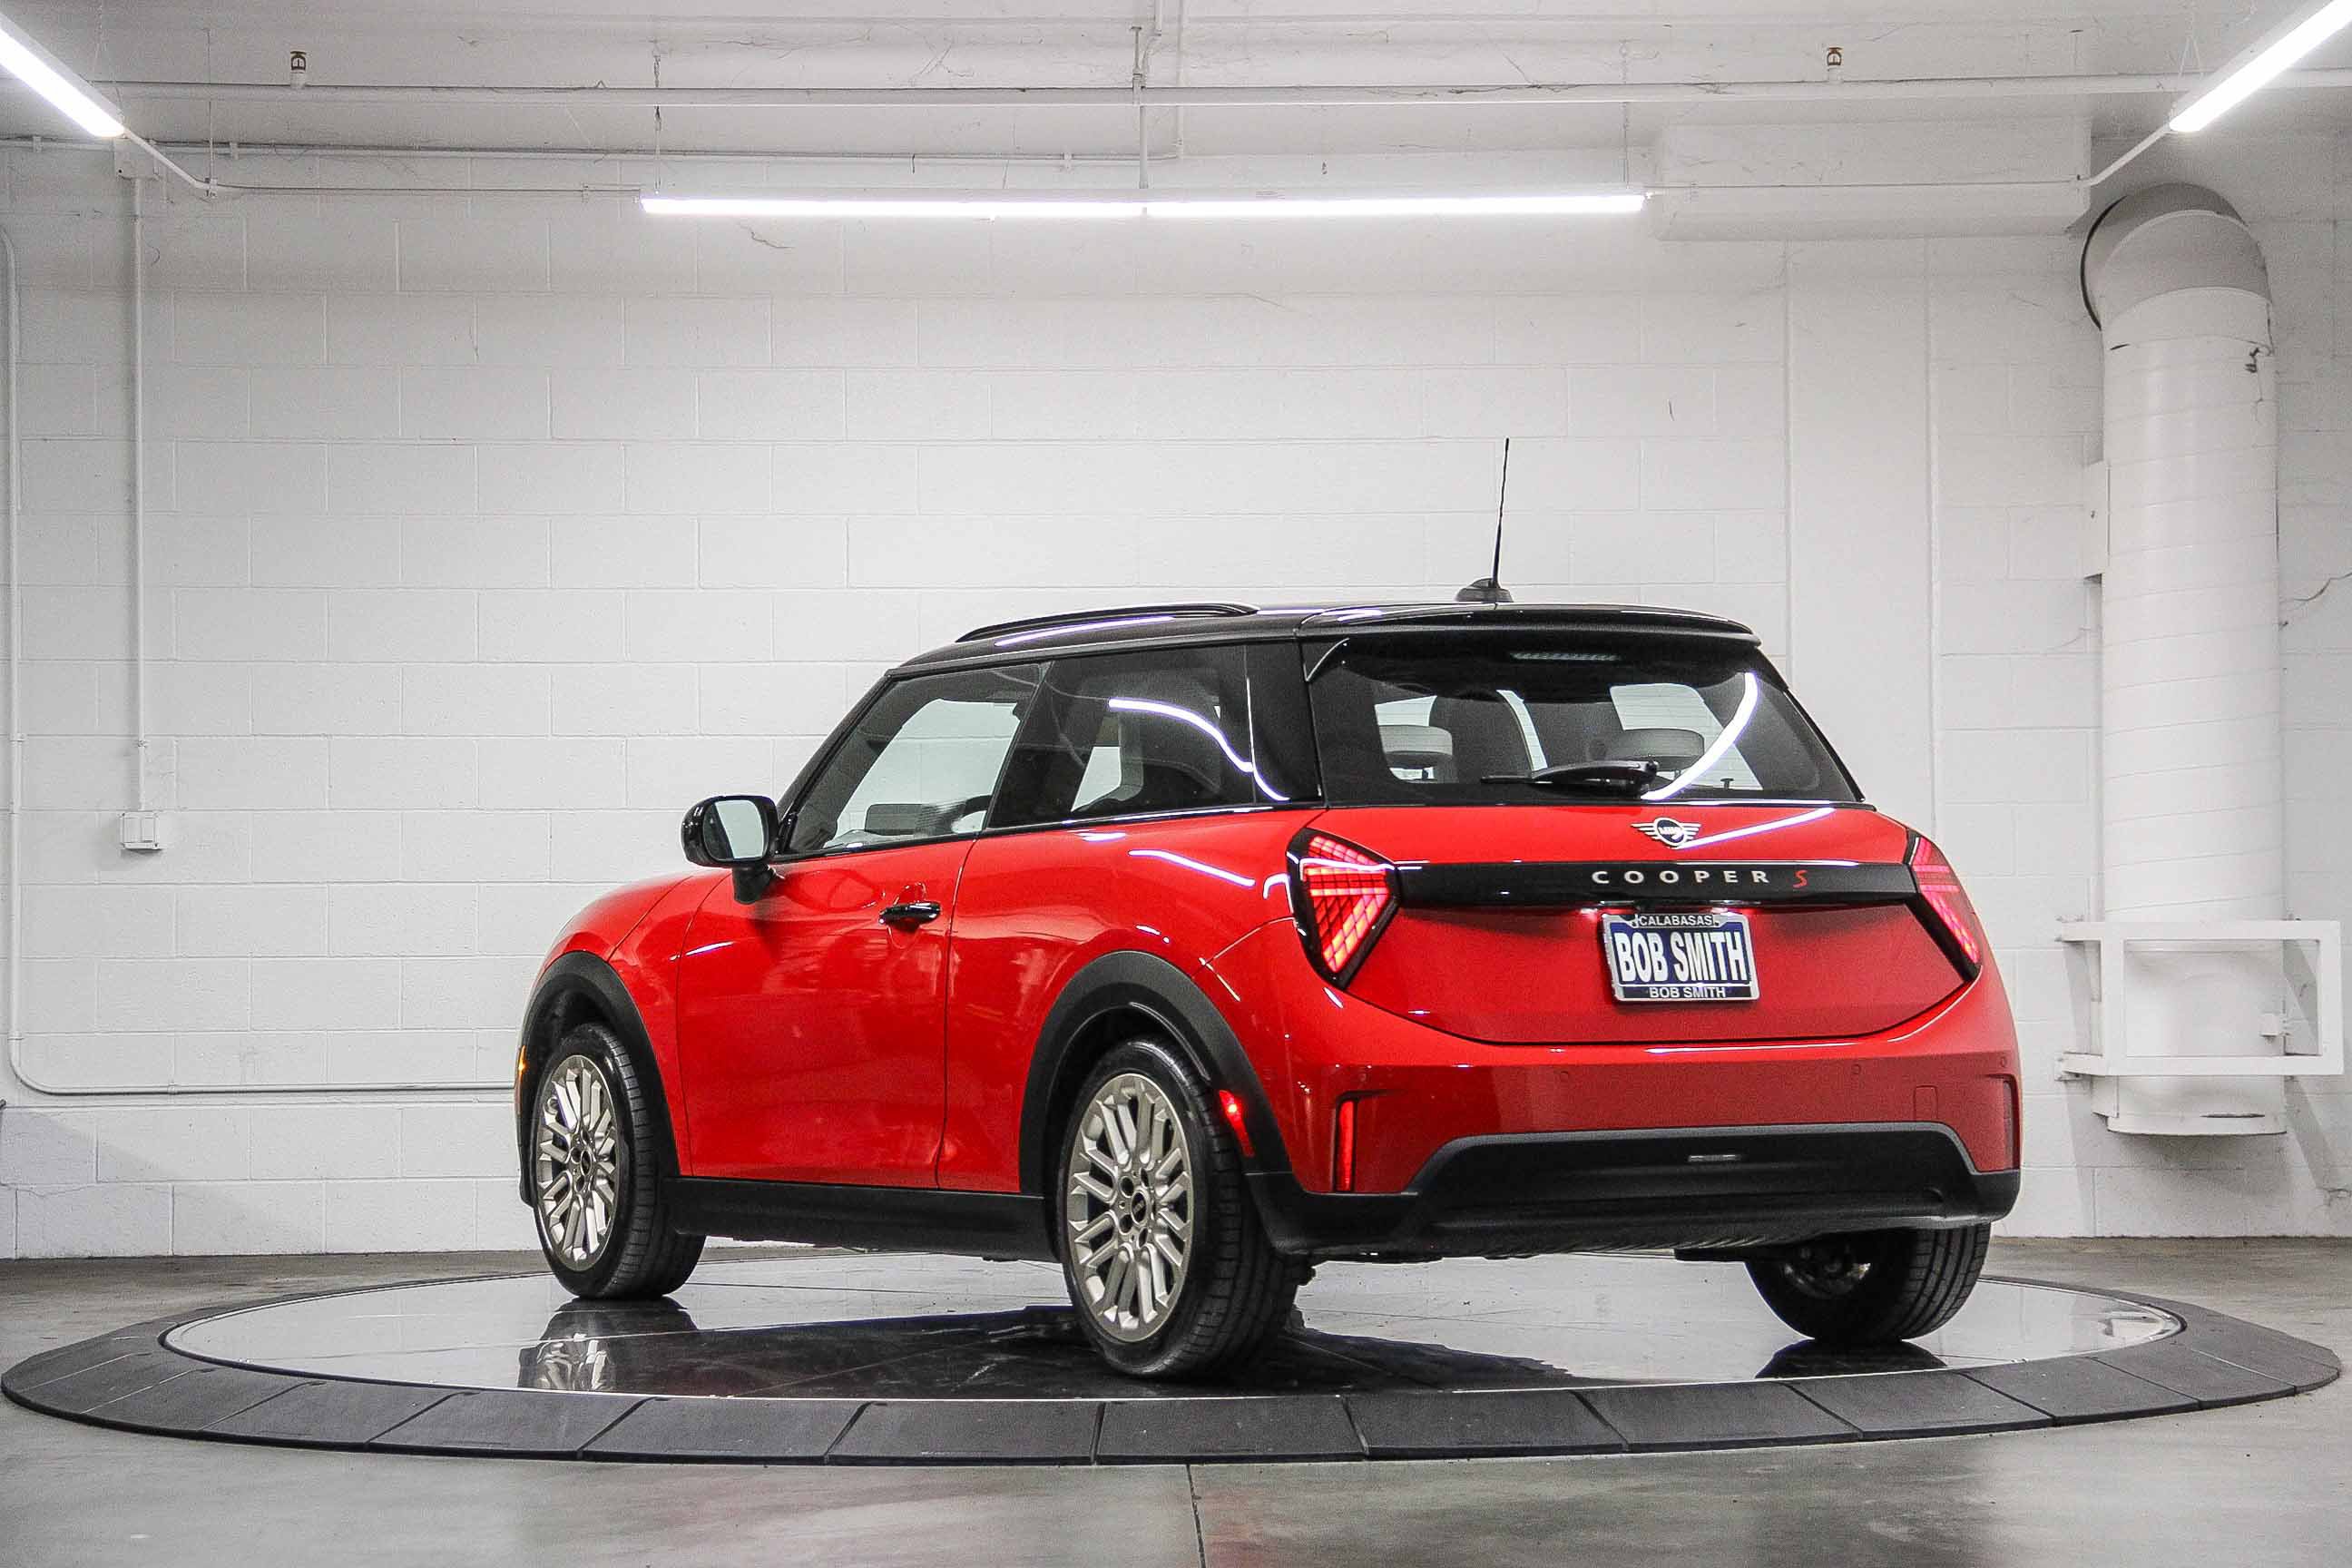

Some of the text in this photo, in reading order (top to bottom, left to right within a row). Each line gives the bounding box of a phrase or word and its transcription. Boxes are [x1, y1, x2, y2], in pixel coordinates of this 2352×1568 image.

[1592, 869, 1808, 888] COOPER S
[1639, 915, 1713, 926] CALABASAS
[1614, 931, 1748, 983] BOB SMITH
[1649, 986, 1726, 998] BOB SMITH
